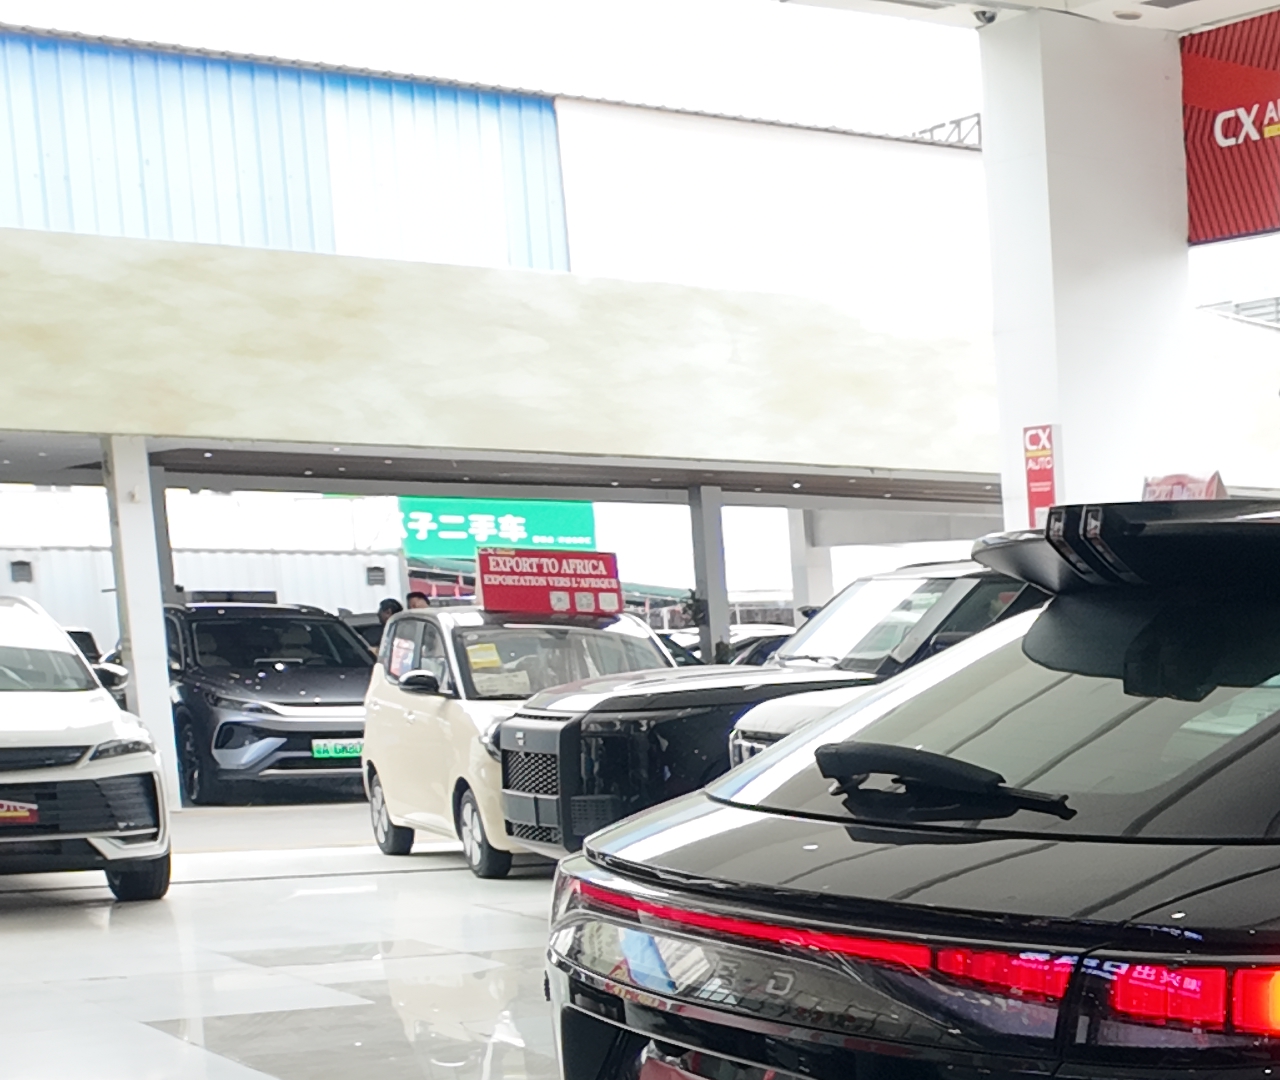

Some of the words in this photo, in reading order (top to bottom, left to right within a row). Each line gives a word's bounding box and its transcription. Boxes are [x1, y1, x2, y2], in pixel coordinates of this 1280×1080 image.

[1214, 104, 1261, 148] CX
[1025, 428, 1051, 451] CX
[1027, 456, 1053, 470] AUTO
[397, 511, 528, 542] 子二手车
[488, 556, 541, 574] EXPORT
[541, 558, 559, 574] TO
[560, 559, 607, 575] AFRICA
[483, 574, 547, 587] EXPORTATION
